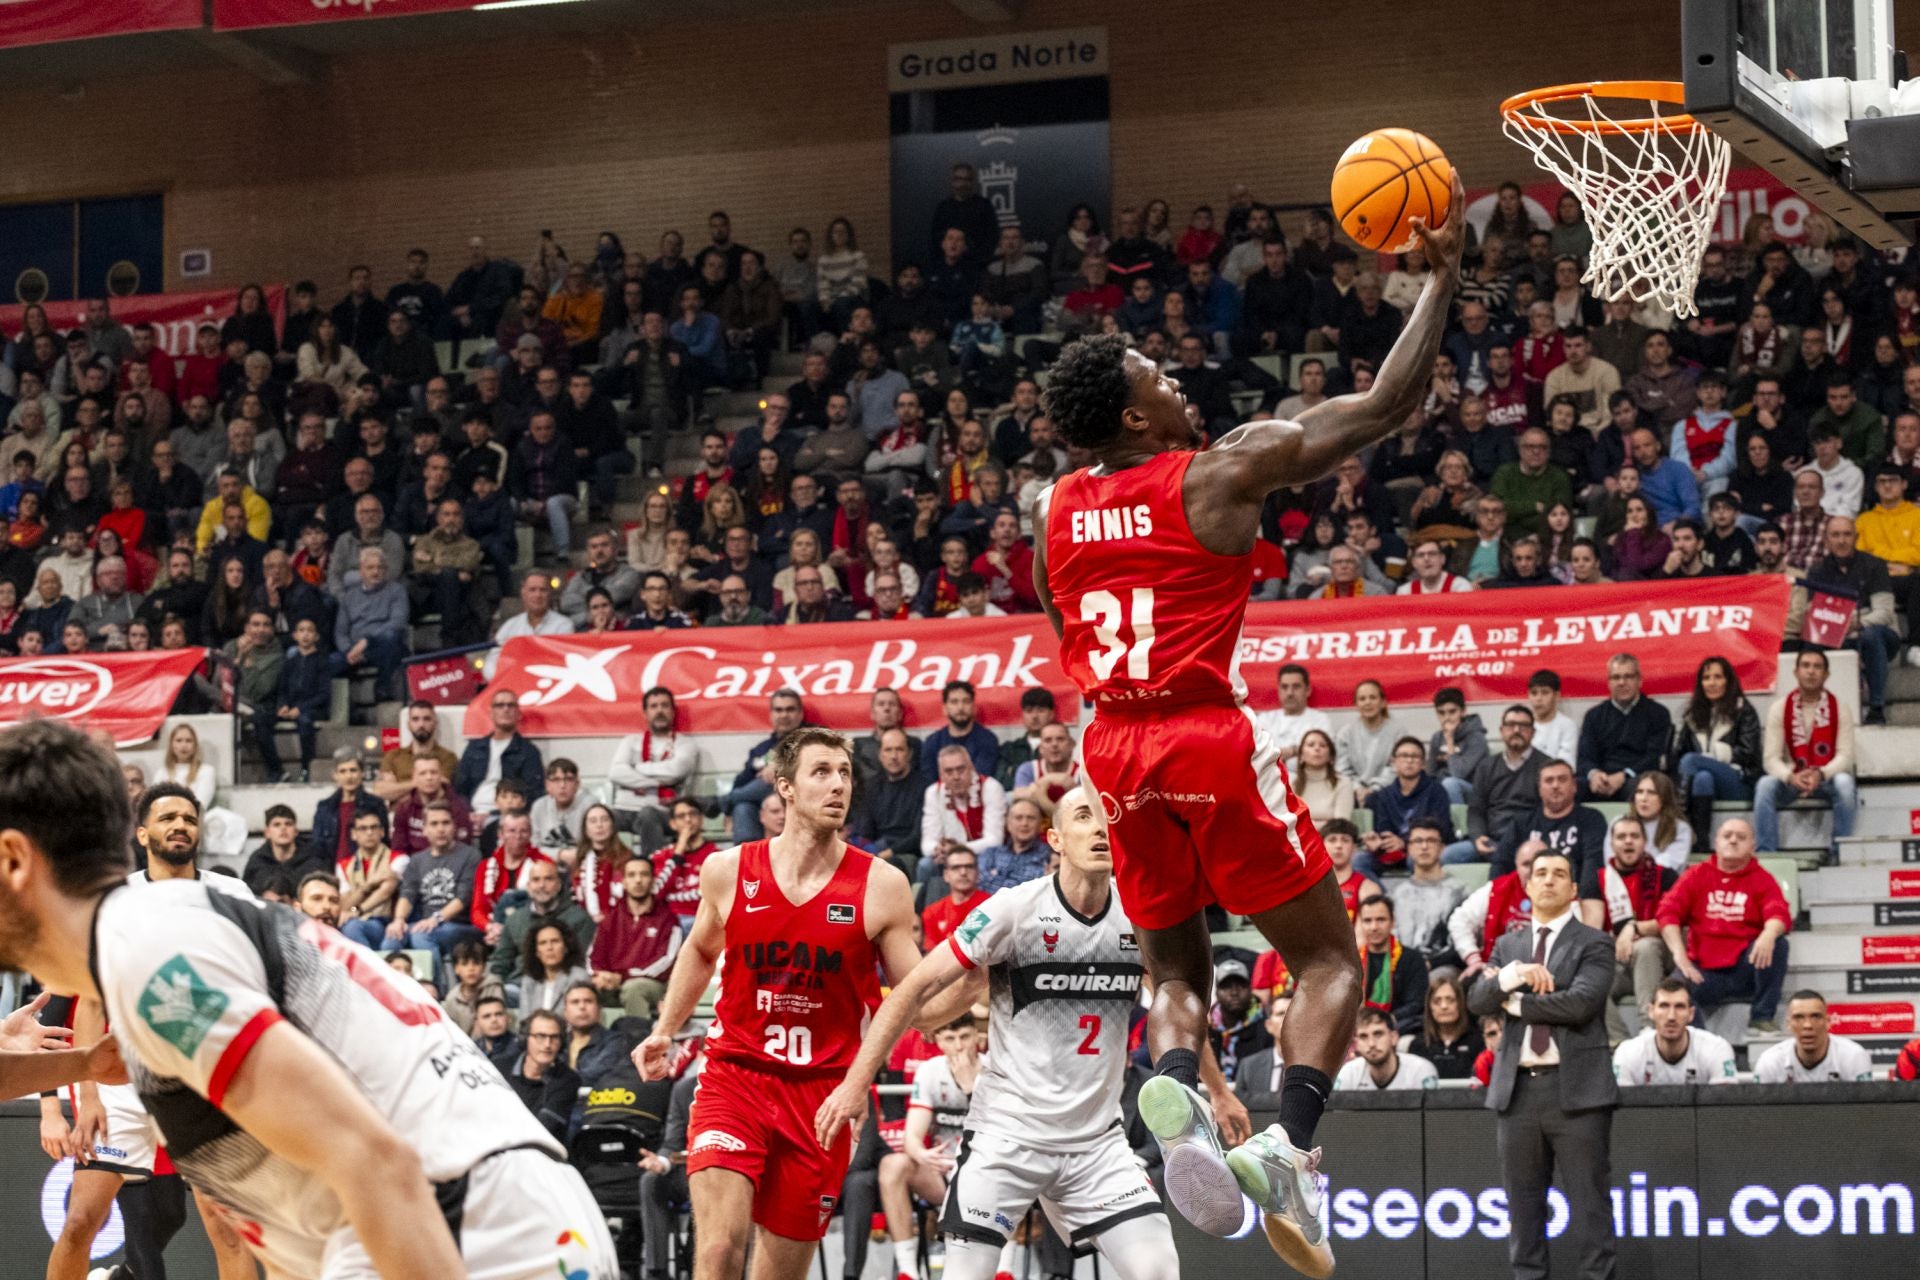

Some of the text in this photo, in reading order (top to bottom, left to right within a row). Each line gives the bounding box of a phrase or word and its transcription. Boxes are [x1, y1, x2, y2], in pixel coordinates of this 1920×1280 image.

[901, 41, 1097, 78] Grada Norte
[1072, 504, 1153, 543] ENNIS
[1080, 587, 1155, 680] 31
[1241, 605, 1753, 663] ESTRELLA DE LEVANTE
[641, 633, 1051, 700] CaixaBank
[1428, 650, 1497, 662] MURCIA
[1173, 793, 1216, 803] MURCIA
[1039, 915, 1062, 923] vive
[743, 940, 843, 974] UCAM
[757, 971, 825, 990] MURCIA
[763, 1024, 813, 1066] 20
[1077, 1014, 1102, 1055] 2
[967, 1207, 991, 1219] vive
